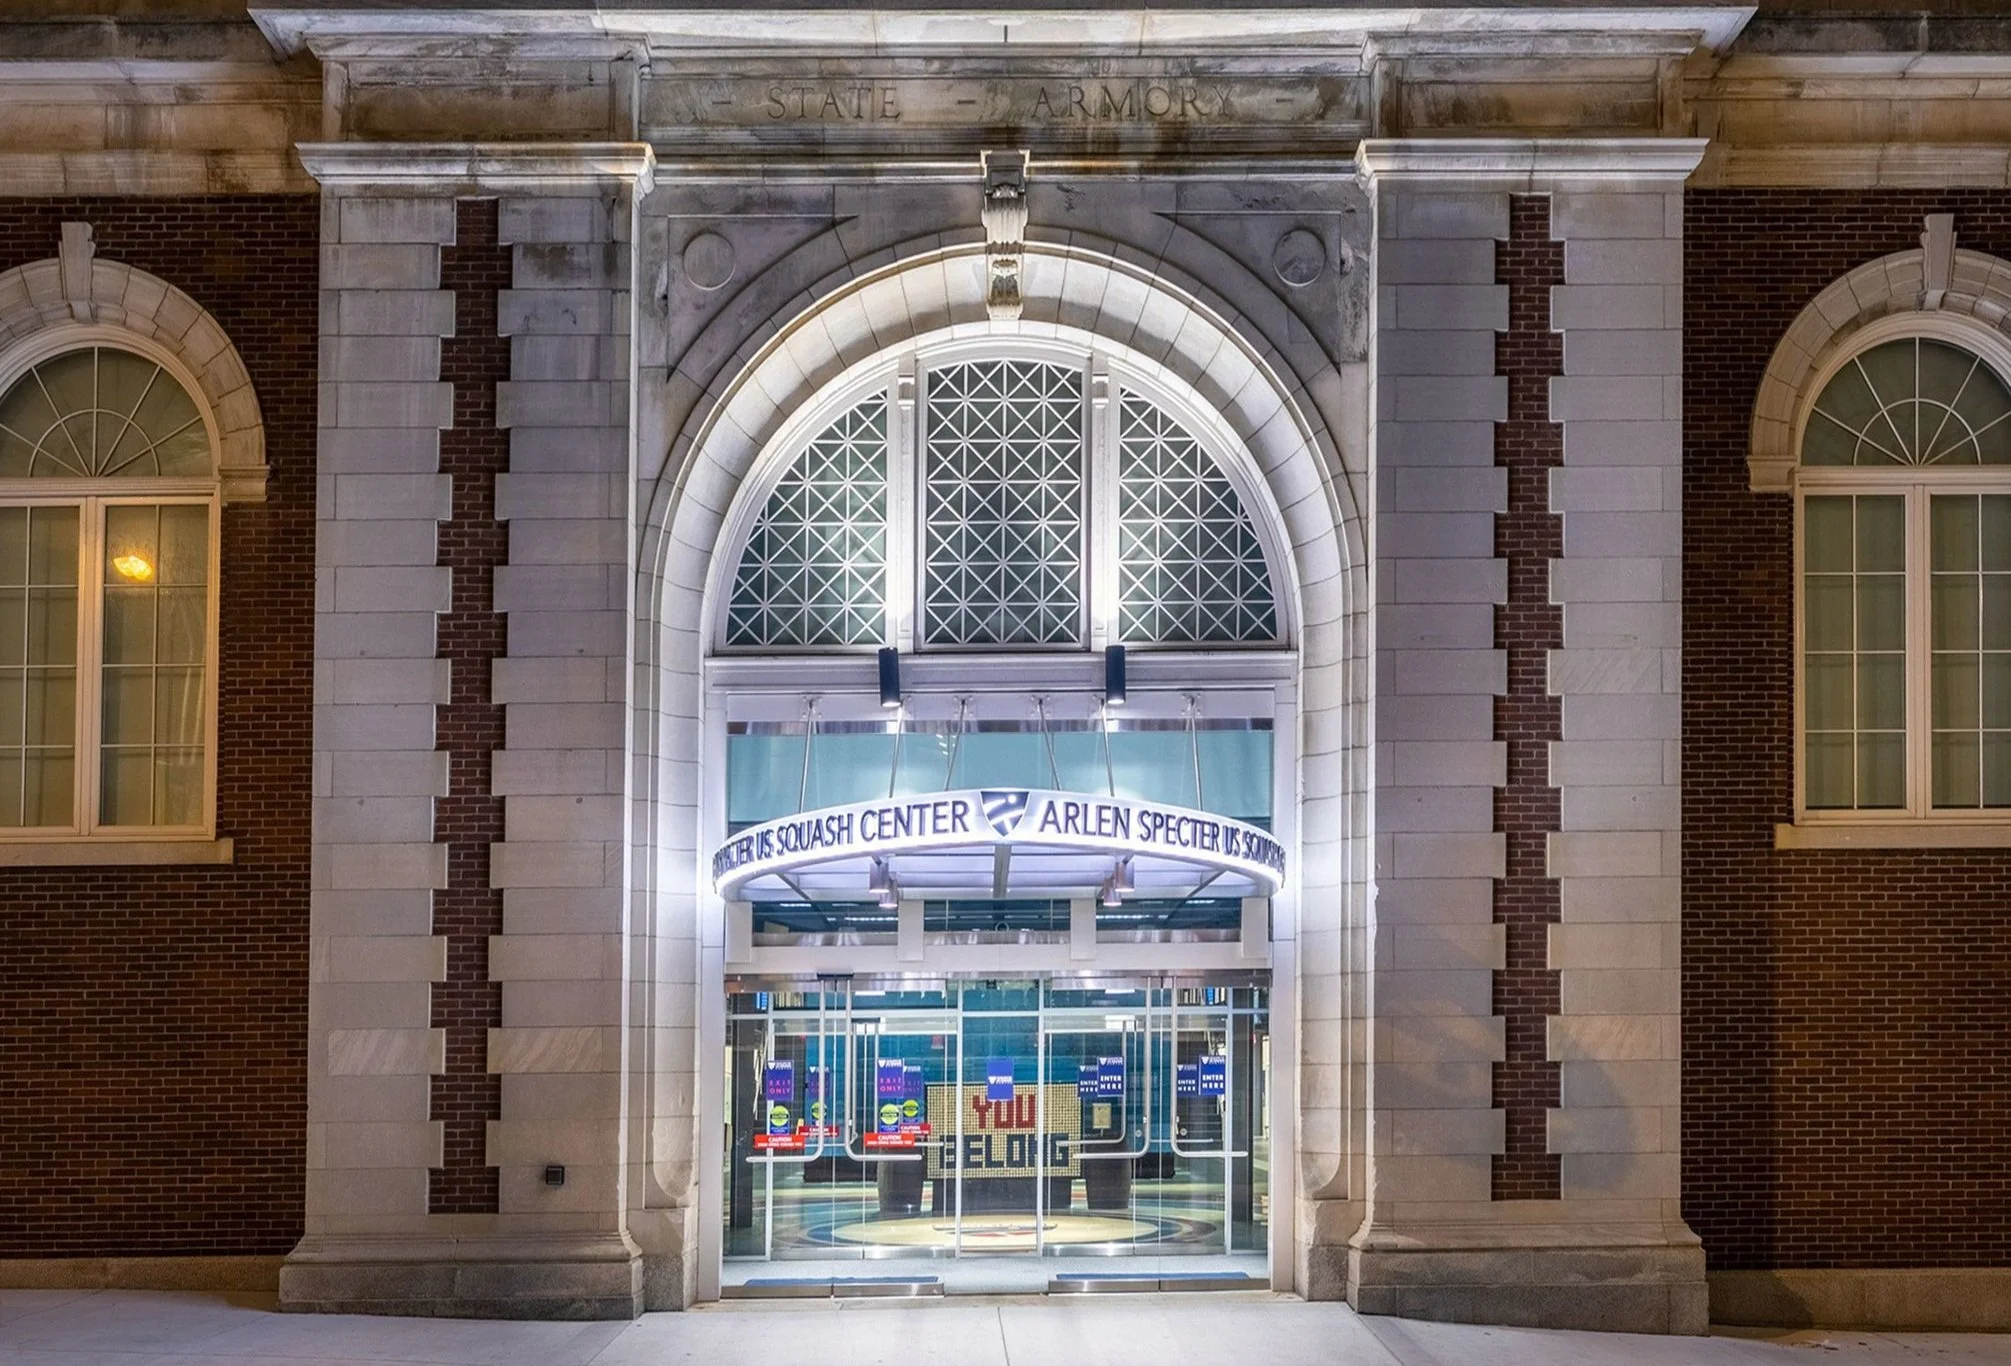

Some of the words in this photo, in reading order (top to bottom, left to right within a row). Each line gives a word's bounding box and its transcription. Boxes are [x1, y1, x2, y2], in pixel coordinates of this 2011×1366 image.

[767, 86, 901, 120] STATE
[1030, 86, 1235, 120] ARMORY
[756, 829, 774, 860] US
[777, 812, 854, 856] SQUASH
[861, 800, 969, 842] CENTER
[1040, 800, 1130, 839] ARLEN
[1138, 809, 1220, 852] SPECTER
[1222, 825, 1241, 857] US
[972, 1094, 1036, 1129] YOU
